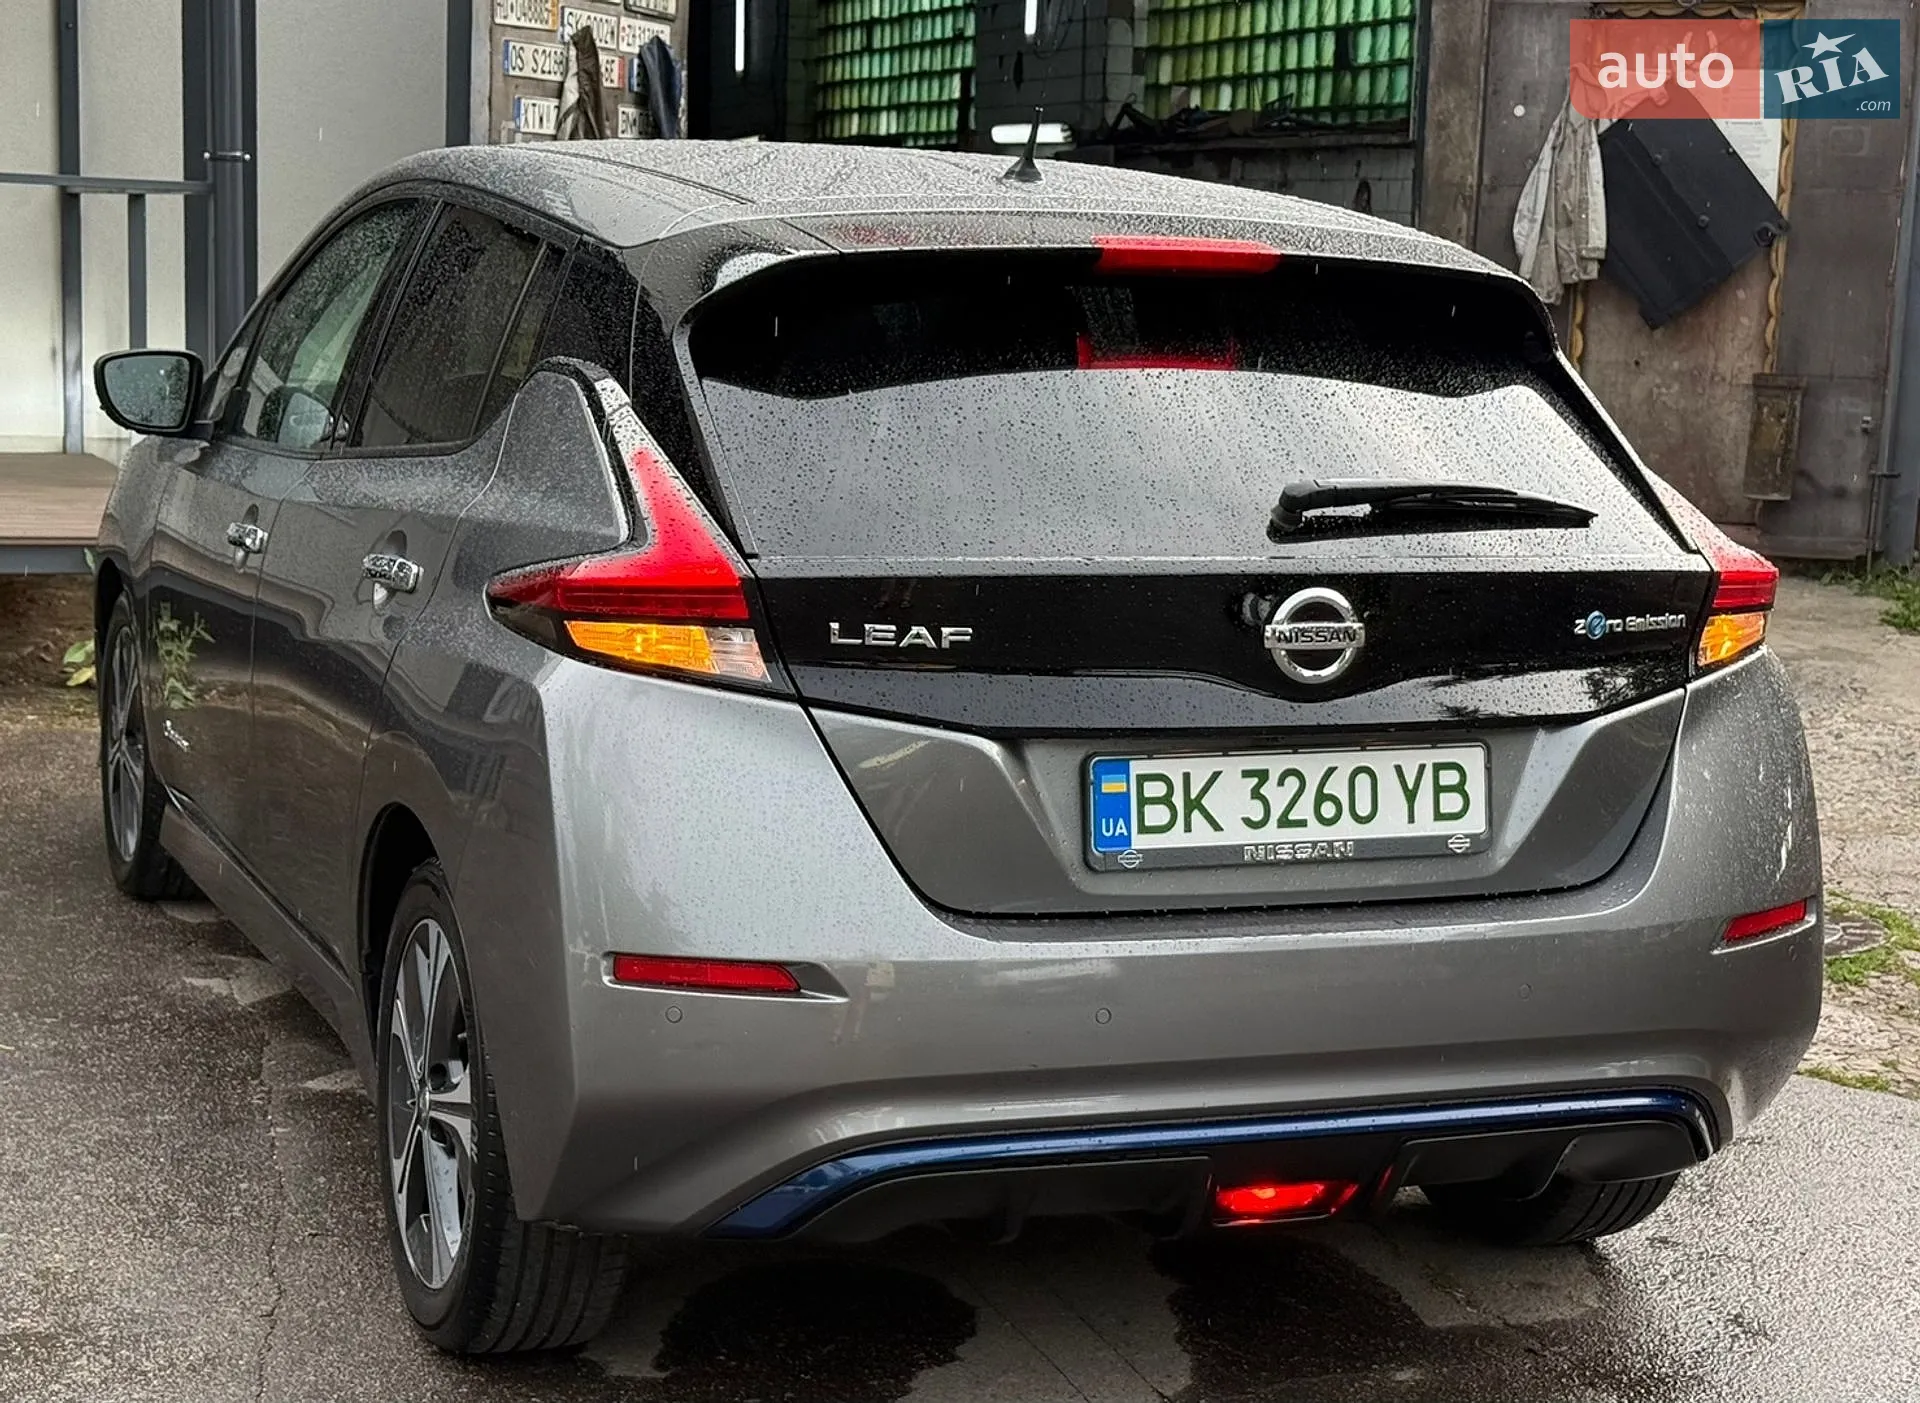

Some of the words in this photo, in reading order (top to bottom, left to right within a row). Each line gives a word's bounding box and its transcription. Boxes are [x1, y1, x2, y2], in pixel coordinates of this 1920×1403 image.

[1626, 613, 1687, 632] Emission
[829, 622, 973, 649] LEAF
[1278, 627, 1356, 643] NISSAN
[1136, 770, 1224, 834] BK
[1241, 765, 1378, 829] 3260
[1394, 761, 1471, 824] YB
[1101, 817, 1128, 836] UA
[1243, 840, 1355, 862] NISSAN
